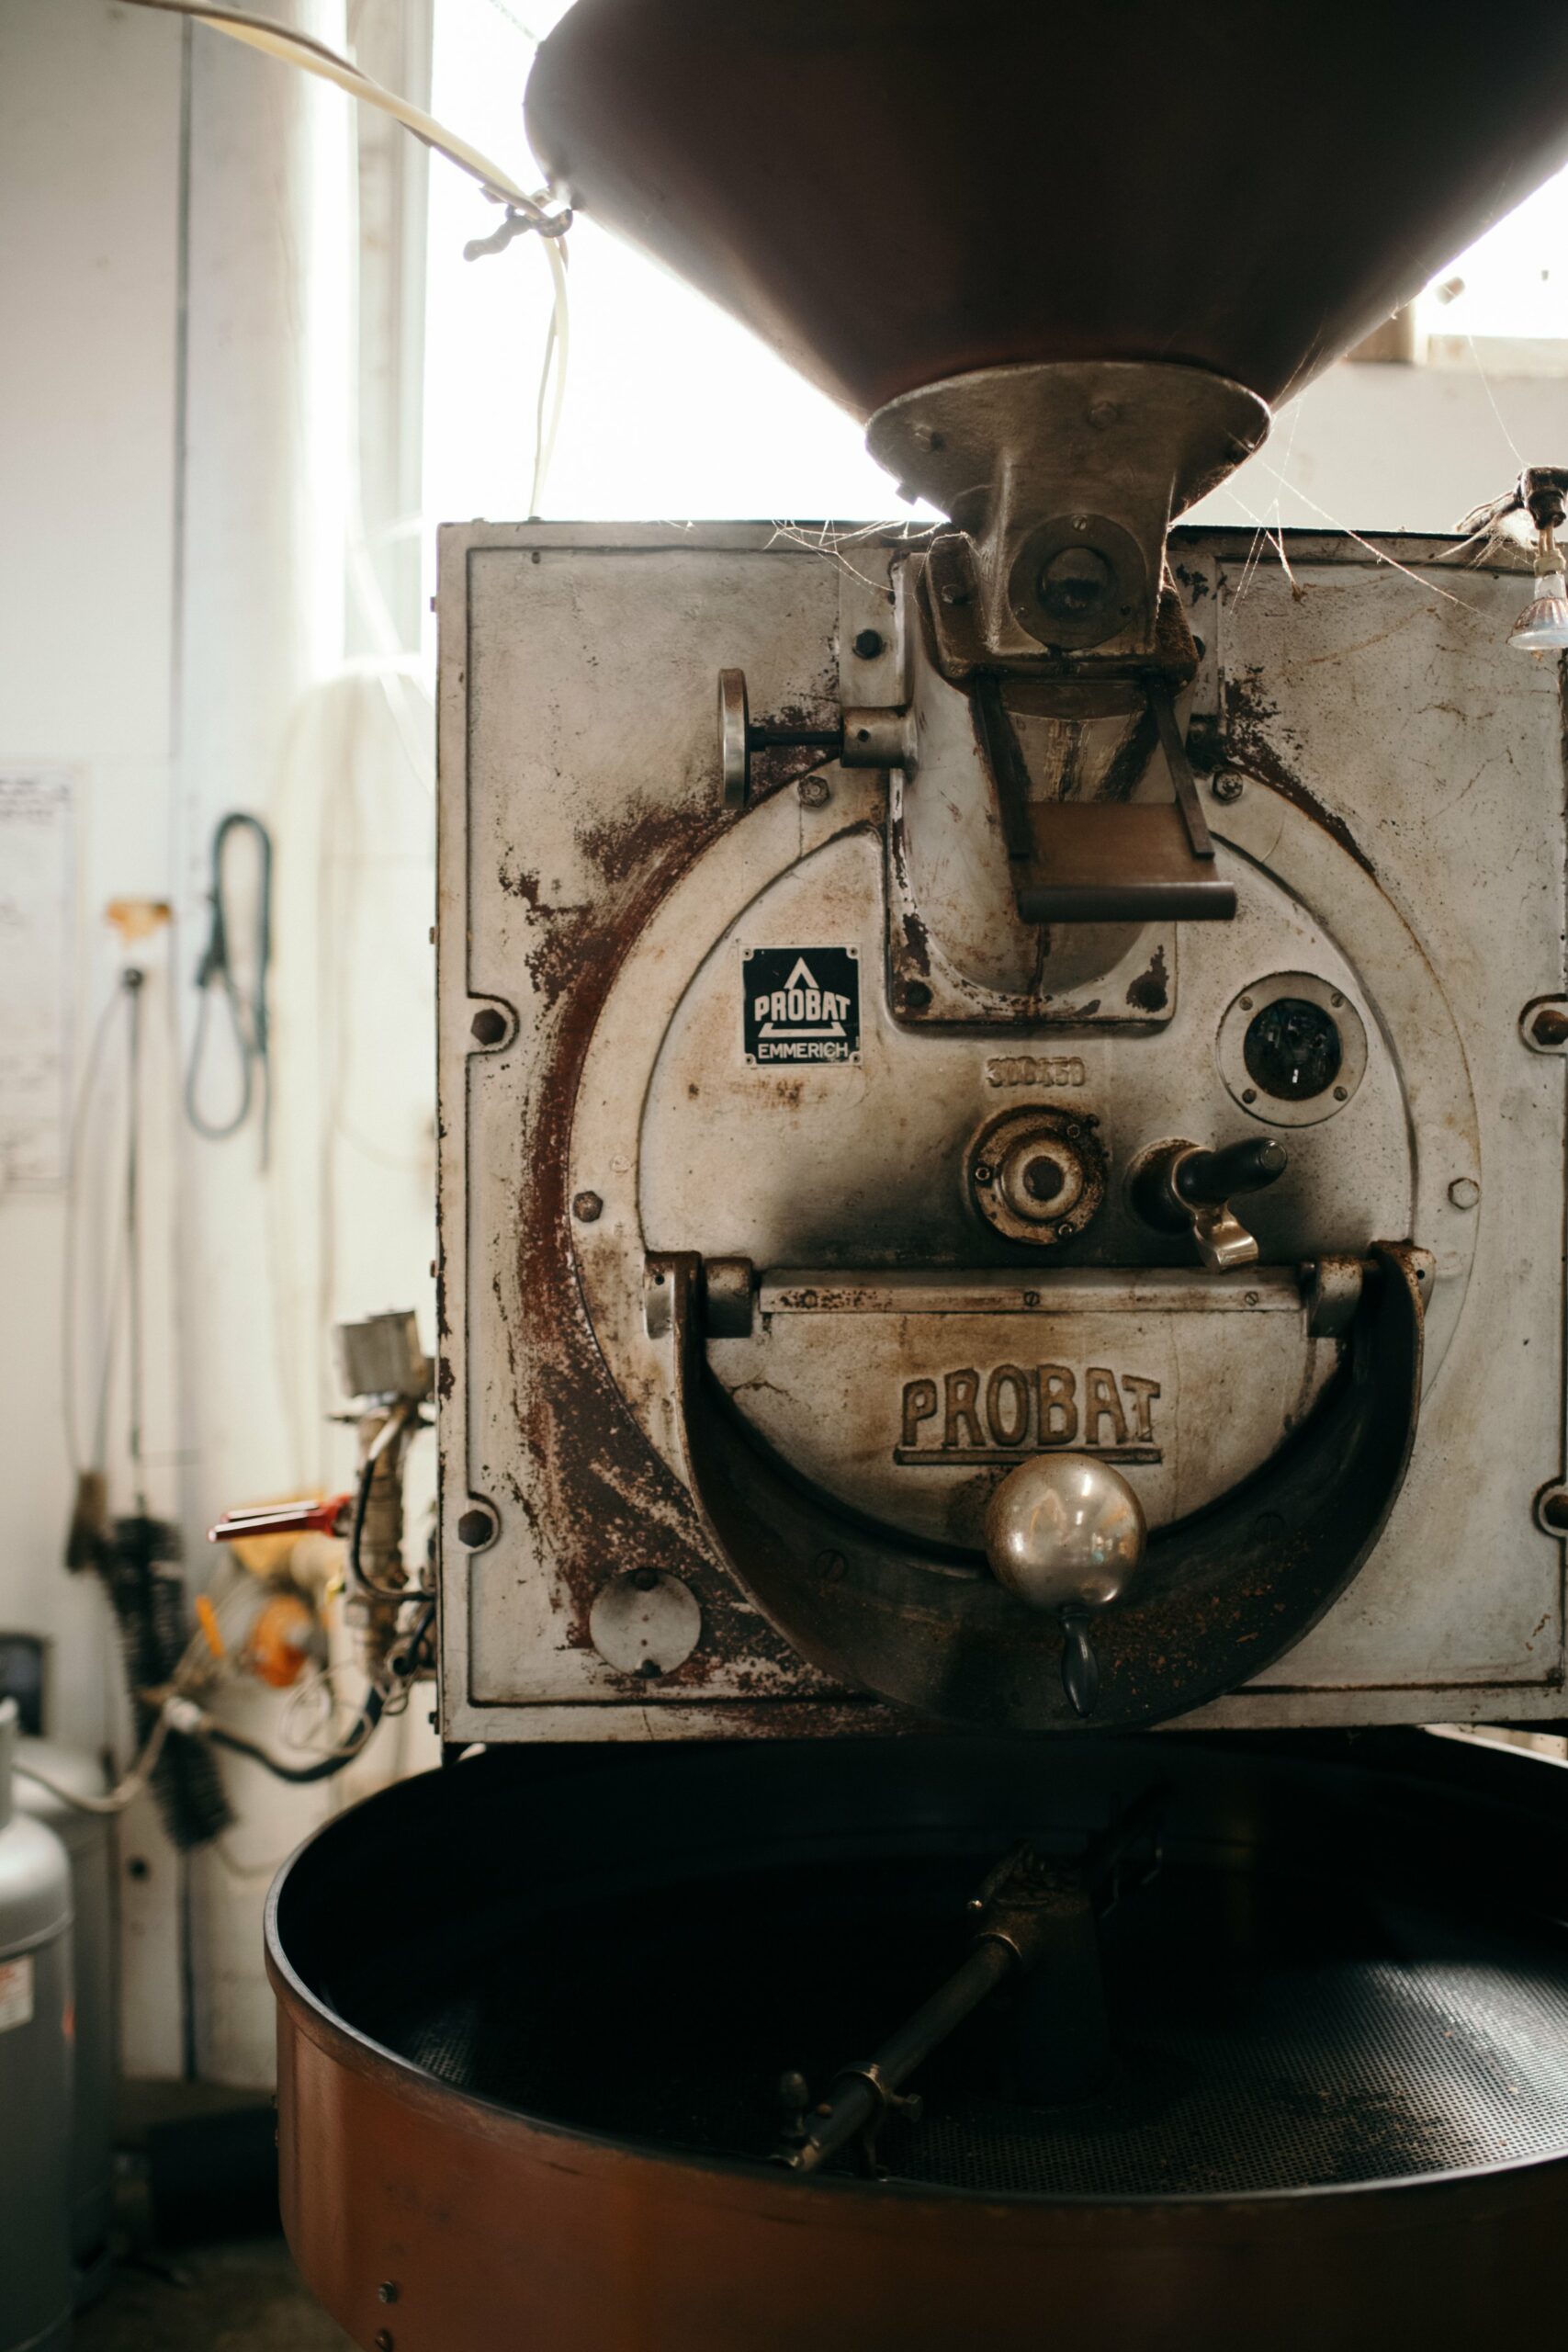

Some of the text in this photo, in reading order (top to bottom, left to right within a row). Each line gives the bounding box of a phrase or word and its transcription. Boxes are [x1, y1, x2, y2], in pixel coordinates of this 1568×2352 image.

[754, 989, 851, 1022] PROBAT
[758, 1042, 849, 1059] EMMERICH
[901, 1363, 1161, 1447] PROBAT
